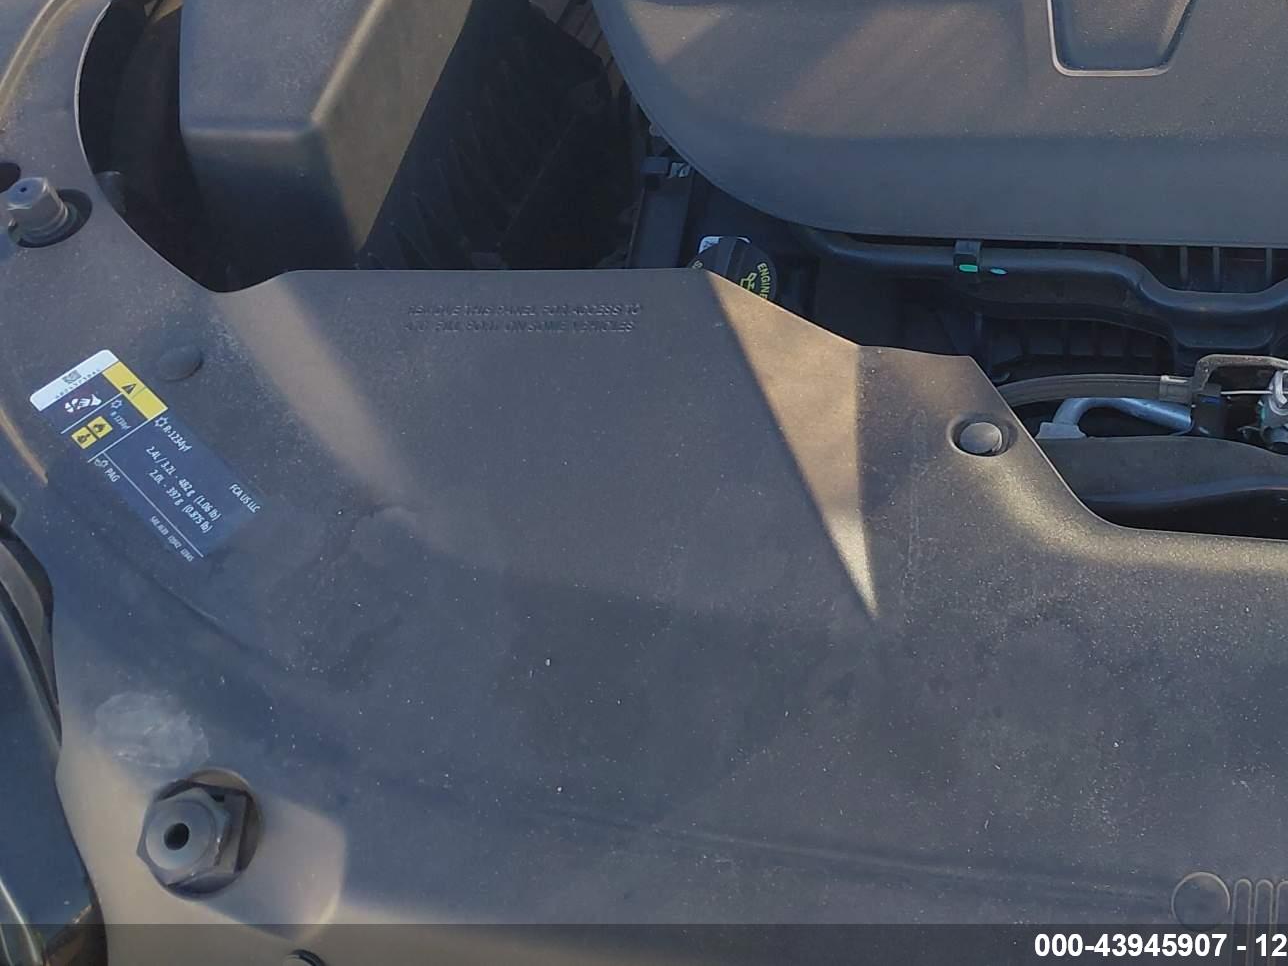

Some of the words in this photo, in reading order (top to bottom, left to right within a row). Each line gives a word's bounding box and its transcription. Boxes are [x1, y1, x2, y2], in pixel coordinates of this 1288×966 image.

[104, 467, 121, 482] PAG
[229, 483, 243, 497] FCA
[240, 494, 251, 504] US
[247, 501, 261, 513] LLC
